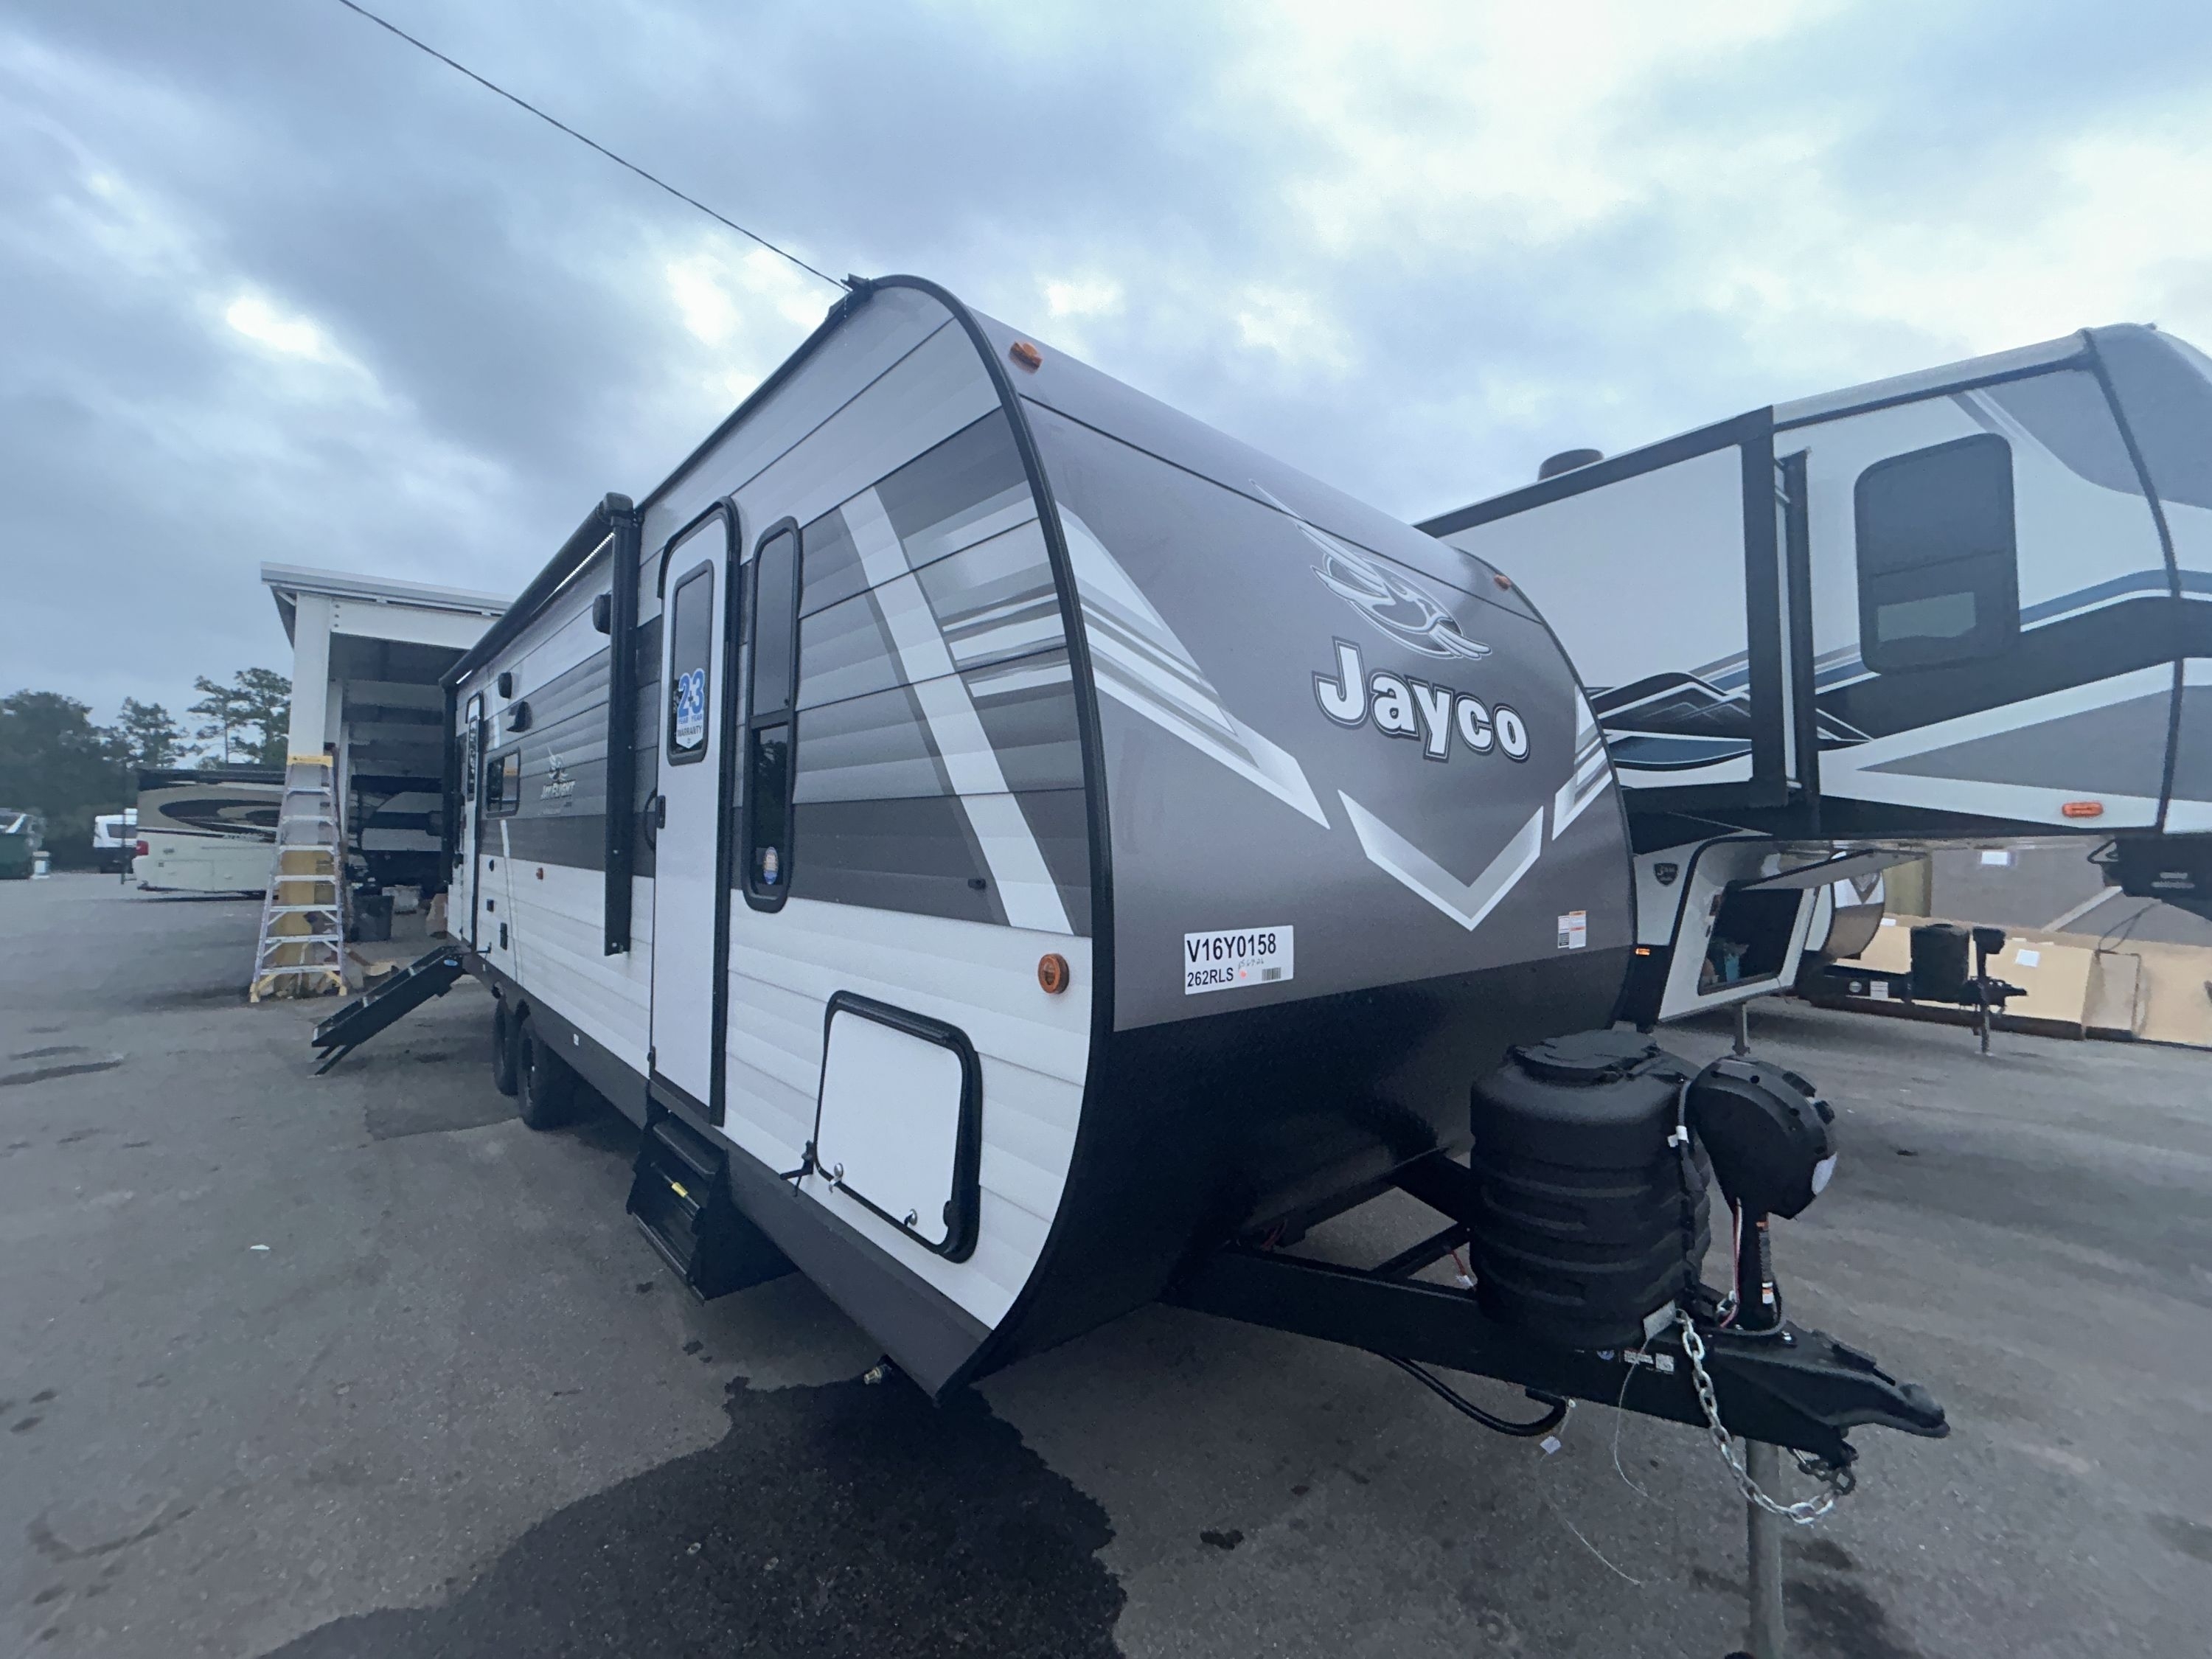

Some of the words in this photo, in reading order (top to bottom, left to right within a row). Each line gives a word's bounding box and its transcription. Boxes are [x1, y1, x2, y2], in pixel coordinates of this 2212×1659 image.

[1313, 638, 1530, 762] Jayco
[677, 726, 702, 737] WARRANTY
[1186, 933, 1276, 962] V16Y0158
[1187, 967, 1234, 987] 262RLS
